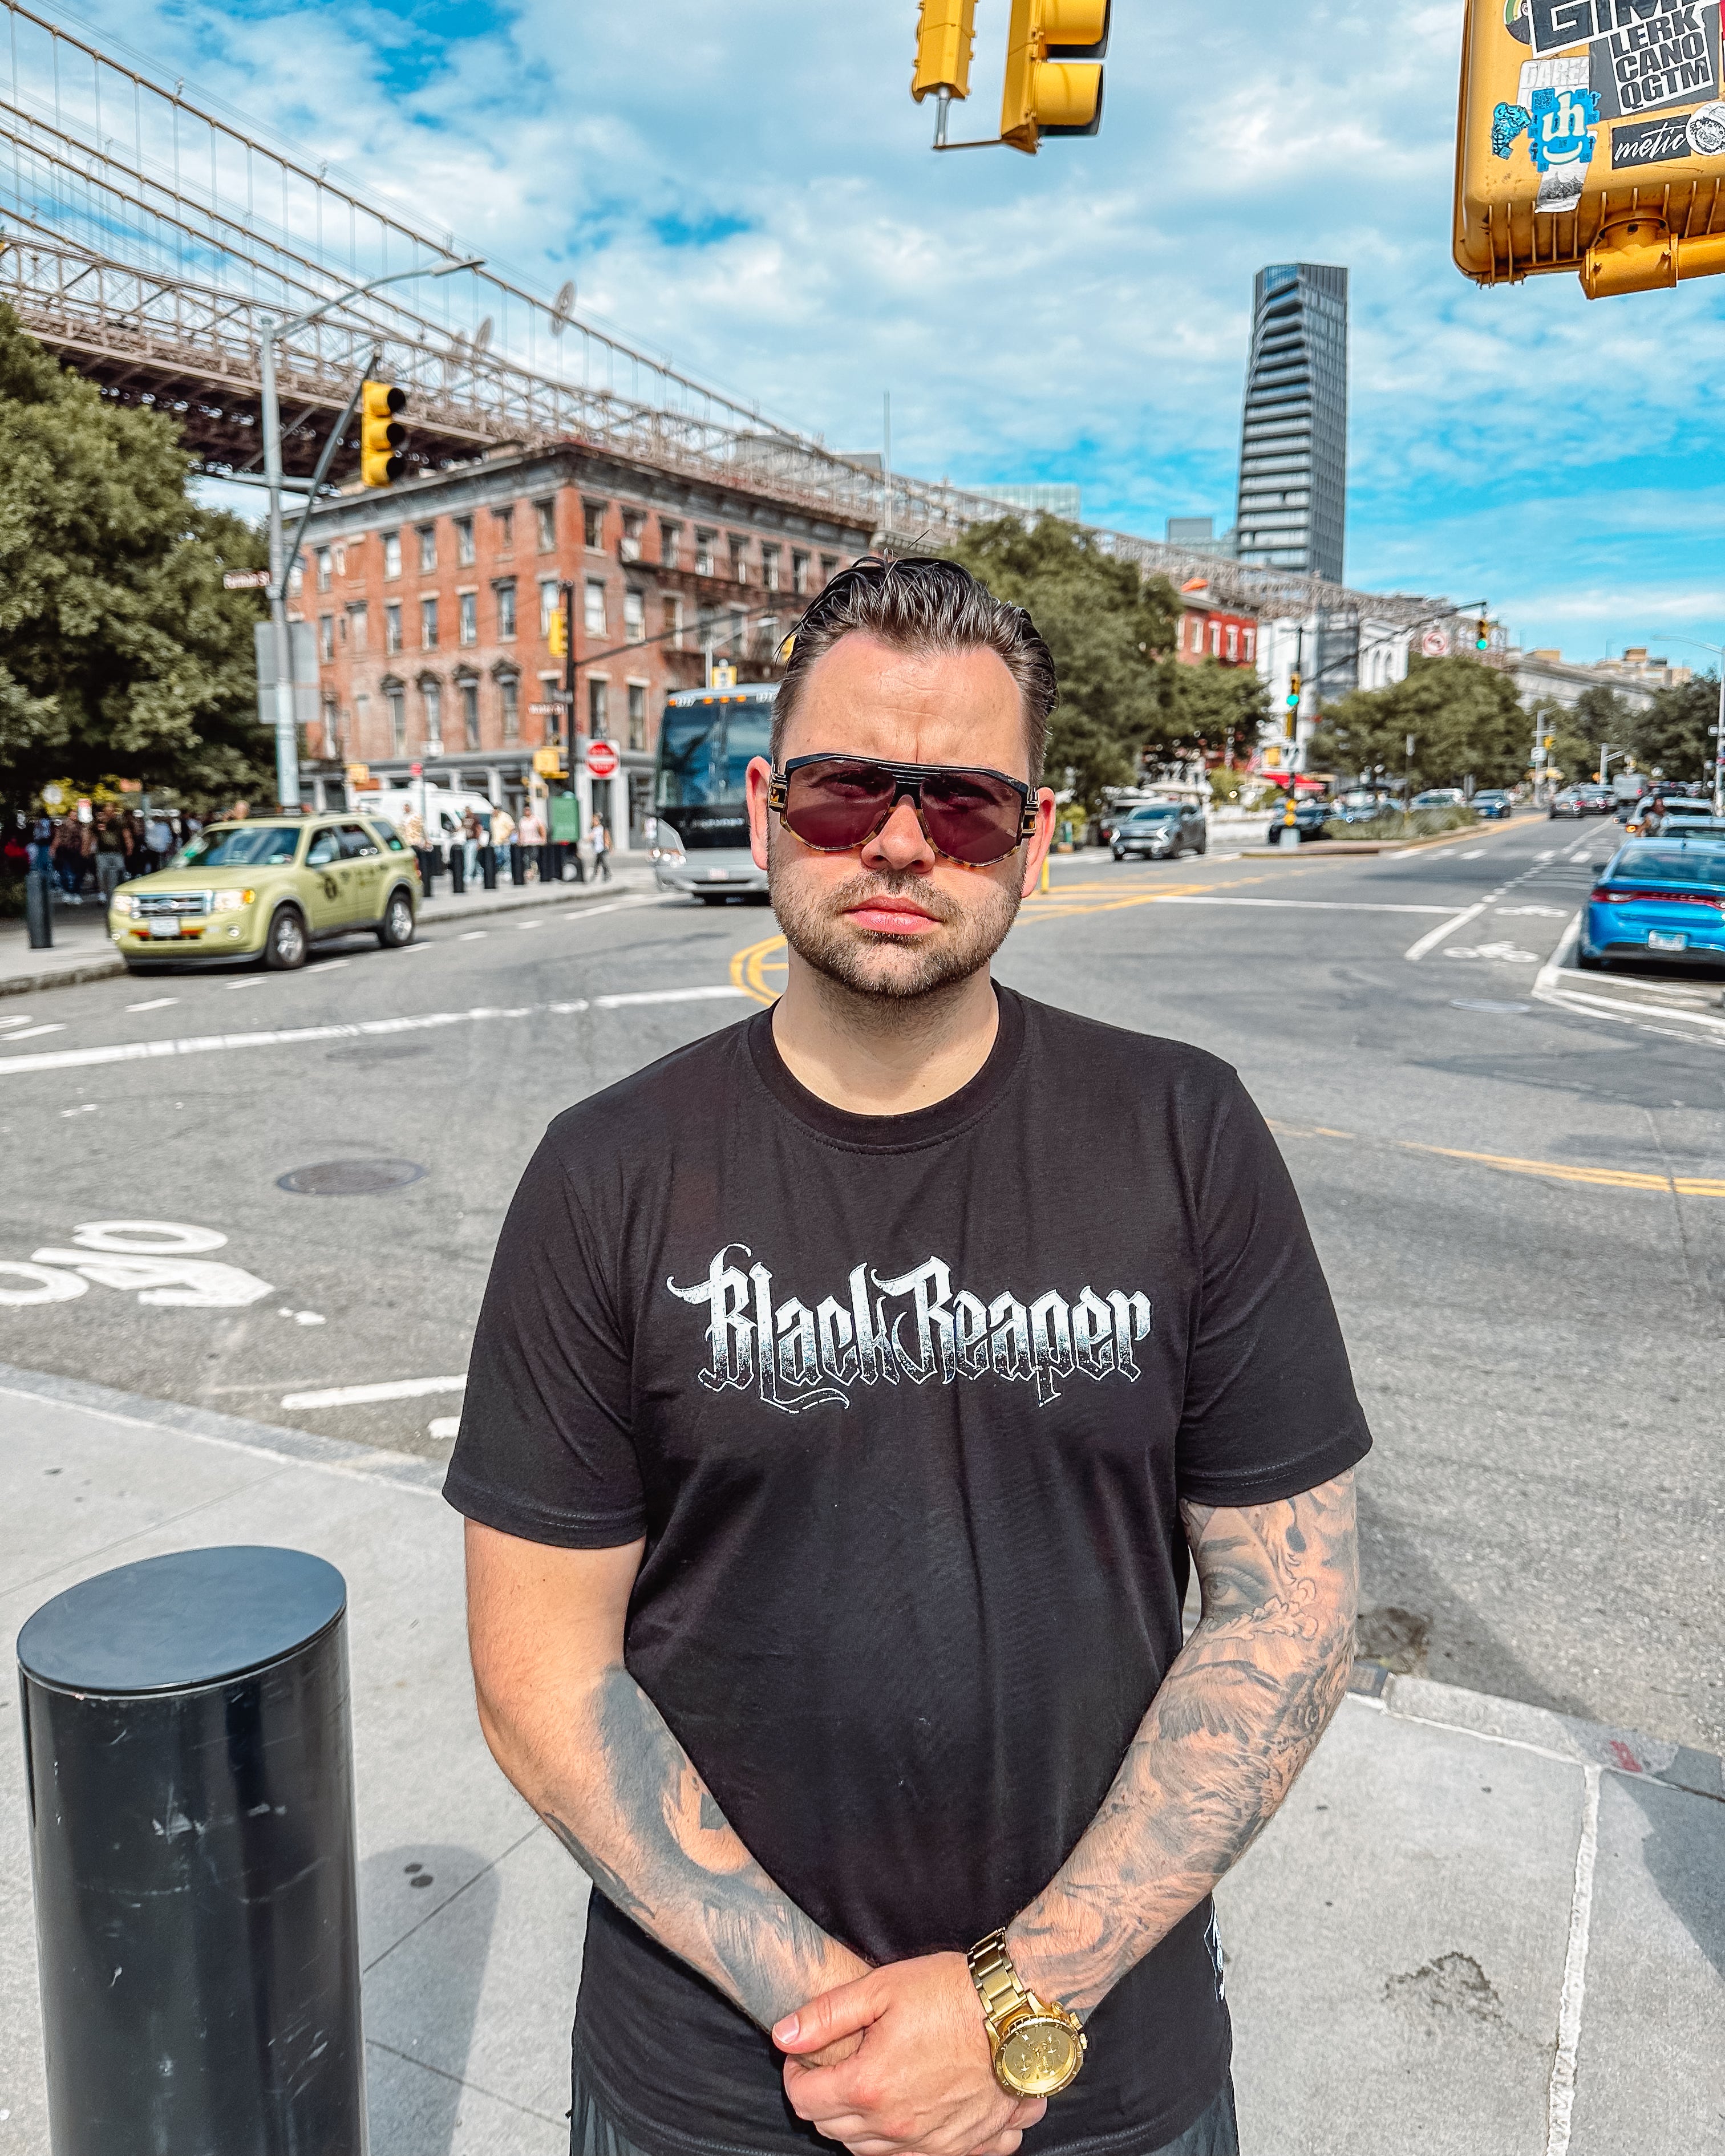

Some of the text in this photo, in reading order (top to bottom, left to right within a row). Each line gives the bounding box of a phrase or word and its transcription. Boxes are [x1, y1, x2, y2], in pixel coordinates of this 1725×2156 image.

[1610, 5, 1700, 57] LERK
[1615, 31, 1704, 82] CANO
[1621, 56, 1710, 109] QGTM
[666, 1242, 1152, 1413] Black Reaper
